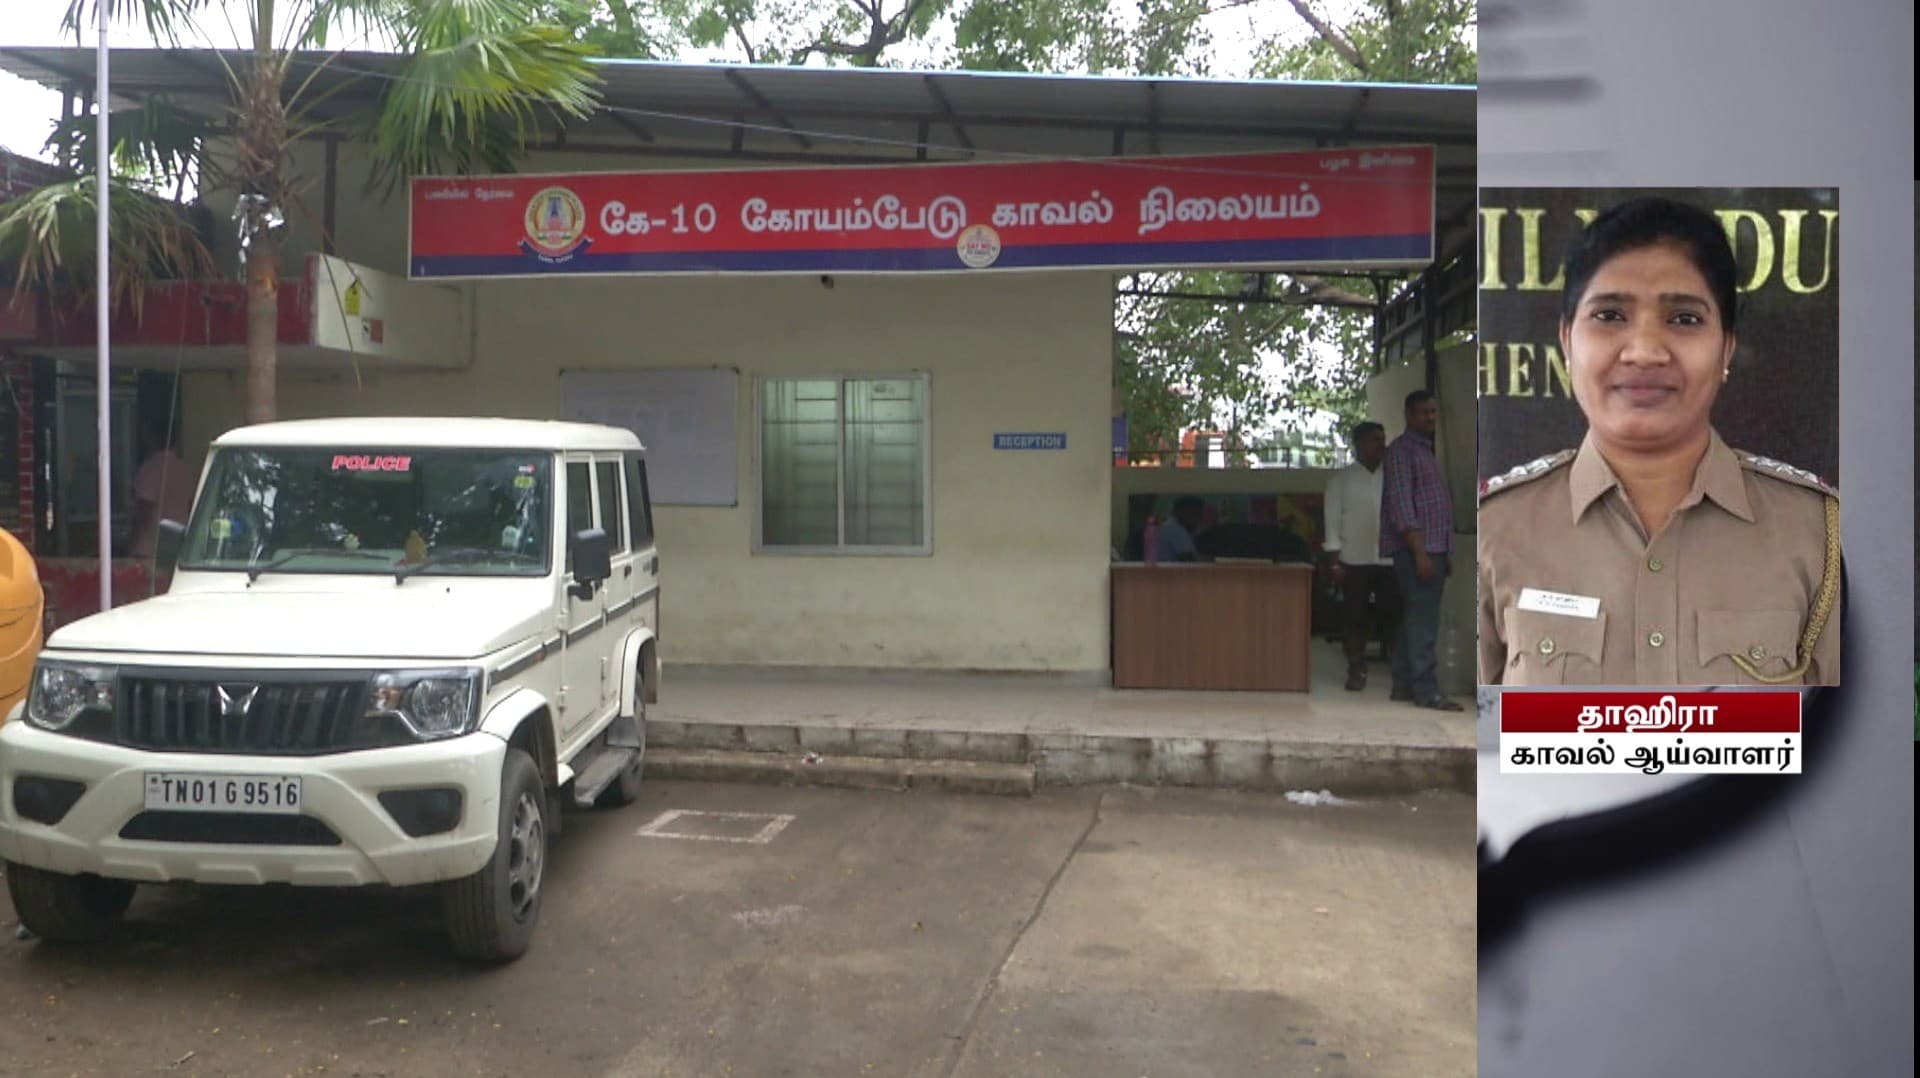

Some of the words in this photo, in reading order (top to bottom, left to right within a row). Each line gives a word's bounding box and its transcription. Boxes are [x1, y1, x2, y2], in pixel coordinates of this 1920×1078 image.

[600, 200, 717, 235] கே-10
[740, 194, 967, 240] கோயம்பேடு
[992, 188, 1114, 227] காவல்
[1138, 182, 1321, 235] நிலையம்
[998, 435, 1061, 447] RECEPTION
[331, 455, 412, 472] POLICE
[244, 781, 297, 806] 9516
